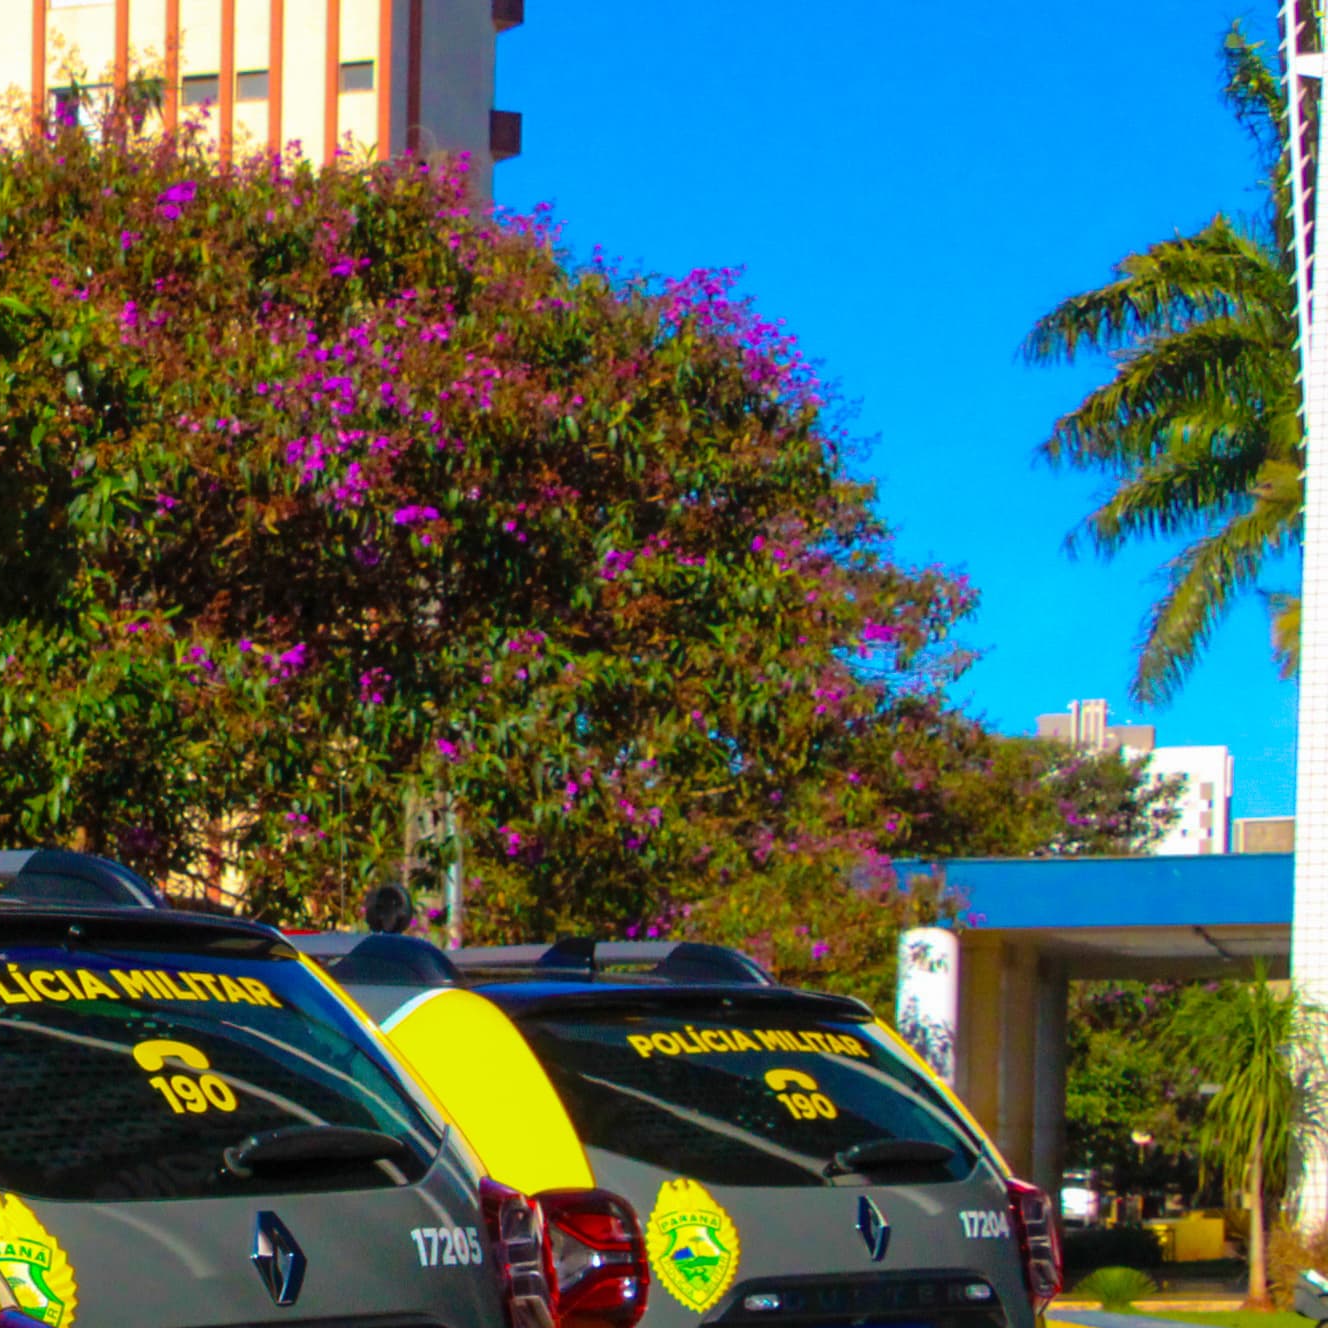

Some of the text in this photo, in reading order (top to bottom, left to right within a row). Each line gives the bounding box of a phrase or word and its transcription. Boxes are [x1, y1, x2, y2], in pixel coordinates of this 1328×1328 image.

[109, 969, 283, 1008] MILITAR
[626, 1025, 870, 1058] POLÍCIA MILITAR
[149, 1074, 237, 1114] 190
[777, 1092, 838, 1120] 190
[959, 1210, 1010, 1239] 17204
[411, 1227, 482, 1267] 17205
